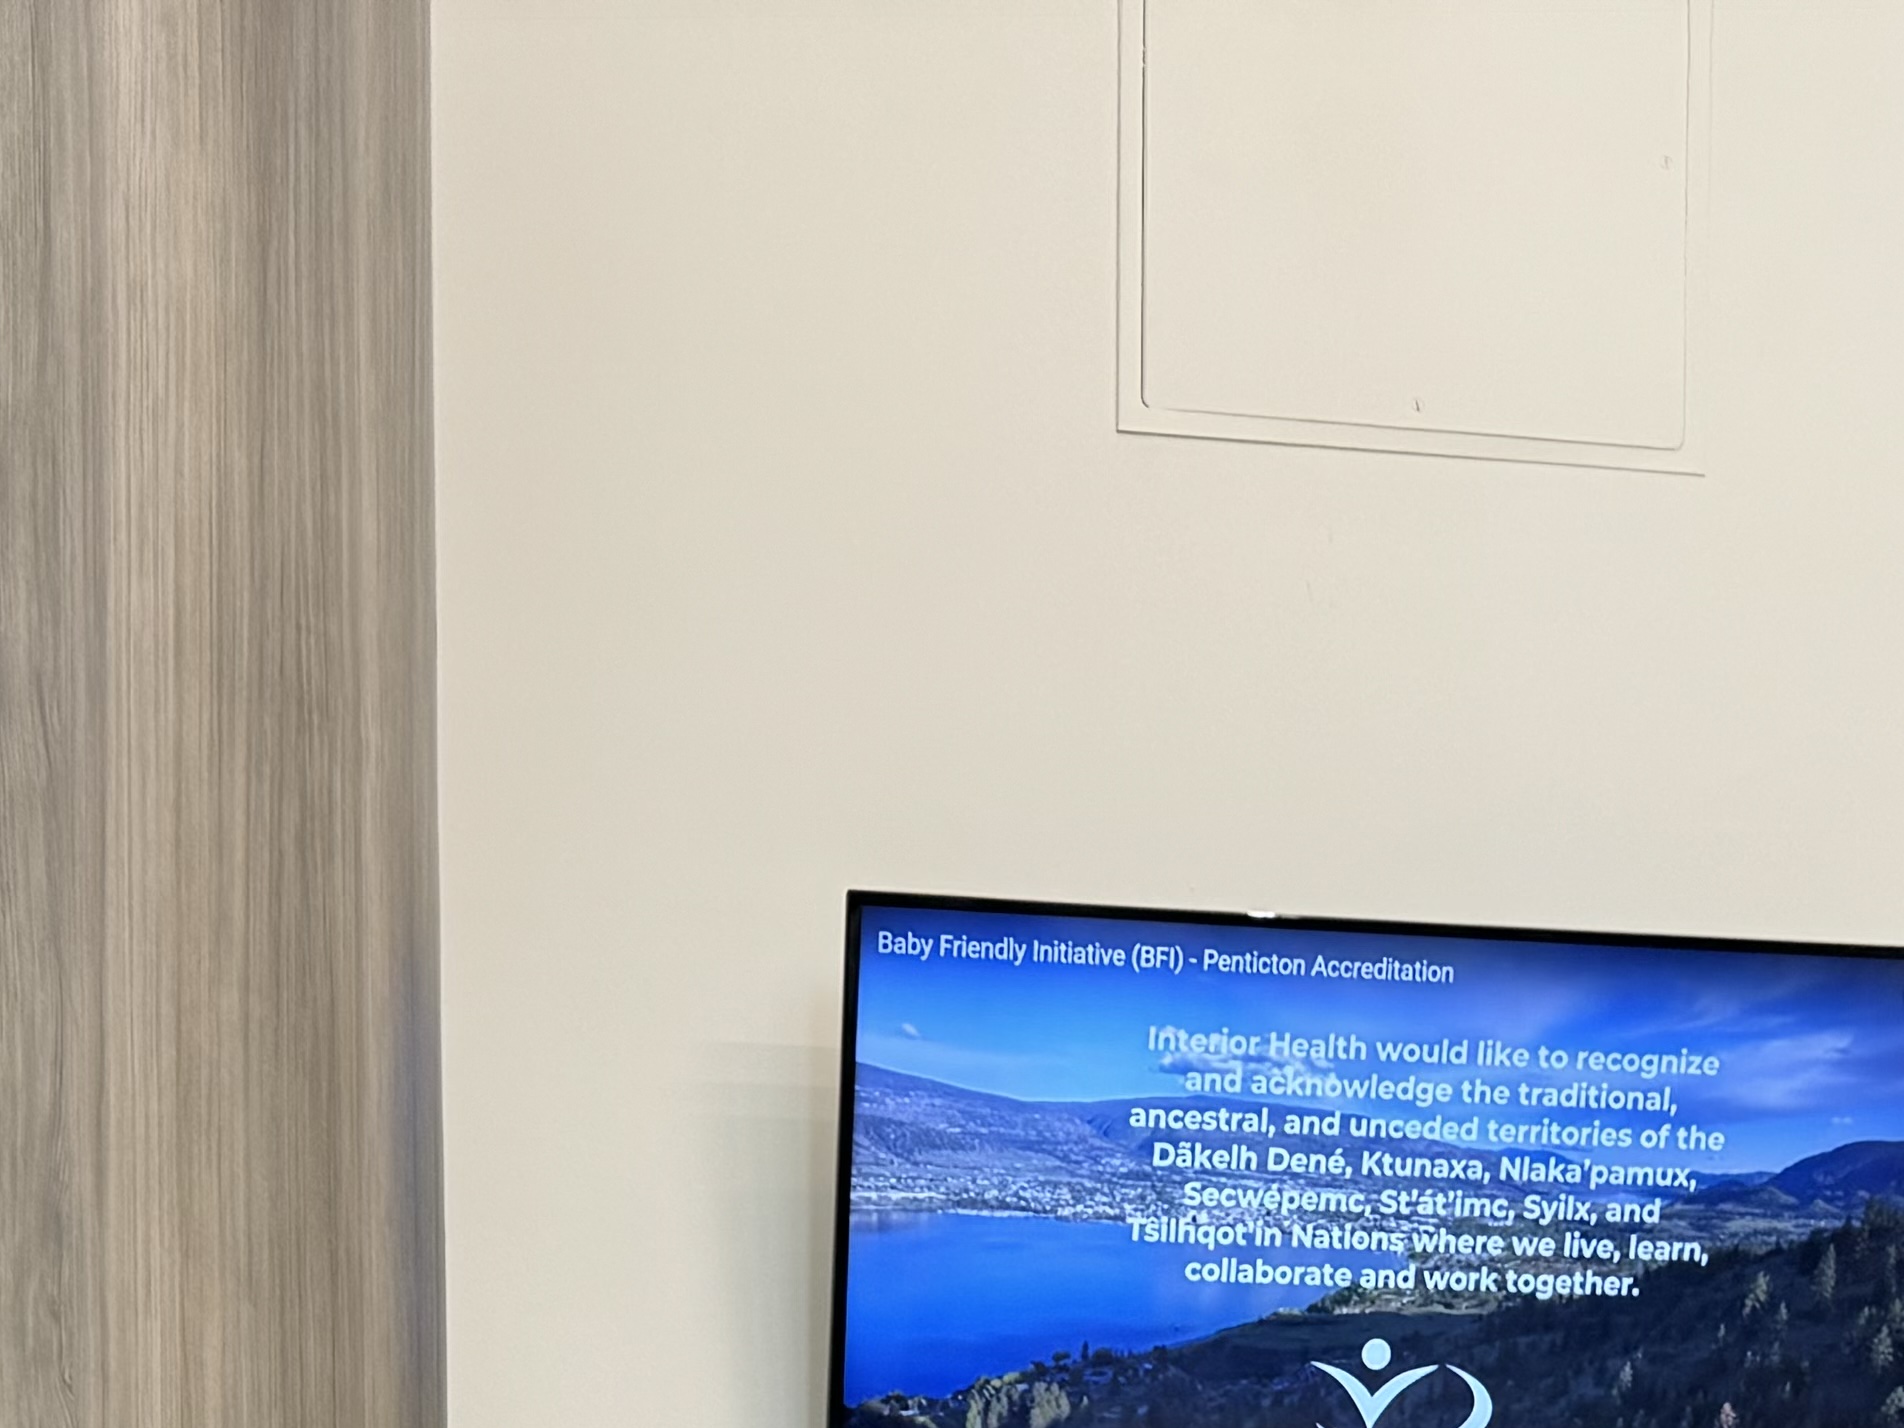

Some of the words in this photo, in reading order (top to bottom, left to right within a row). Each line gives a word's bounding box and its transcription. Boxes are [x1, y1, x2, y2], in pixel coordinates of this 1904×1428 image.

[877, 931, 933, 961] Baby
[939, 934, 1027, 966] Friendly
[1033, 940, 1126, 967] Initiative
[1131, 943, 1183, 974] (BFI)
[1203, 949, 1305, 976] Penticton
[1311, 955, 1455, 983] Accreditation
[1148, 1026, 1260, 1055] Interior
[1269, 1032, 1367, 1060] Health
[1376, 1038, 1468, 1065] would
[1477, 1039, 1530, 1067] like
[1538, 1046, 1568, 1069] to
[1576, 1048, 1720, 1080] recognize
[1185, 1068, 1242, 1093] and
[1251, 1066, 1452, 1107] acknowledge
[1462, 1079, 1509, 1105] the
[1518, 1082, 1677, 1116] traditional,
[1129, 1107, 1276, 1138] ancestral,
[1284, 1110, 1341, 1137] and
[1350, 1113, 1478, 1141] unceded
[1487, 1118, 1632, 1147] territories
[1640, 1124, 1671, 1149] of
[1677, 1125, 1725, 1151] the
[1267, 1147, 1352, 1179] Dené,
[1361, 1150, 1491, 1185] Ktunaxa,
[1183, 1182, 1372, 1217] Secwépemc,
[1523, 1195, 1598, 1226] Syilx,
[1605, 1198, 1661, 1224] and
[1291, 1223, 1407, 1252] Nations
[1413, 1227, 1504, 1256] where
[1512, 1235, 1555, 1257] we
[1563, 1231, 1620, 1263] live,
[1629, 1234, 1708, 1266] learn,
[1184, 1257, 1352, 1287] collaborate
[1360, 1265, 1416, 1289] and
[1423, 1267, 1497, 1291] work
[1505, 1269, 1639, 1300] together.
